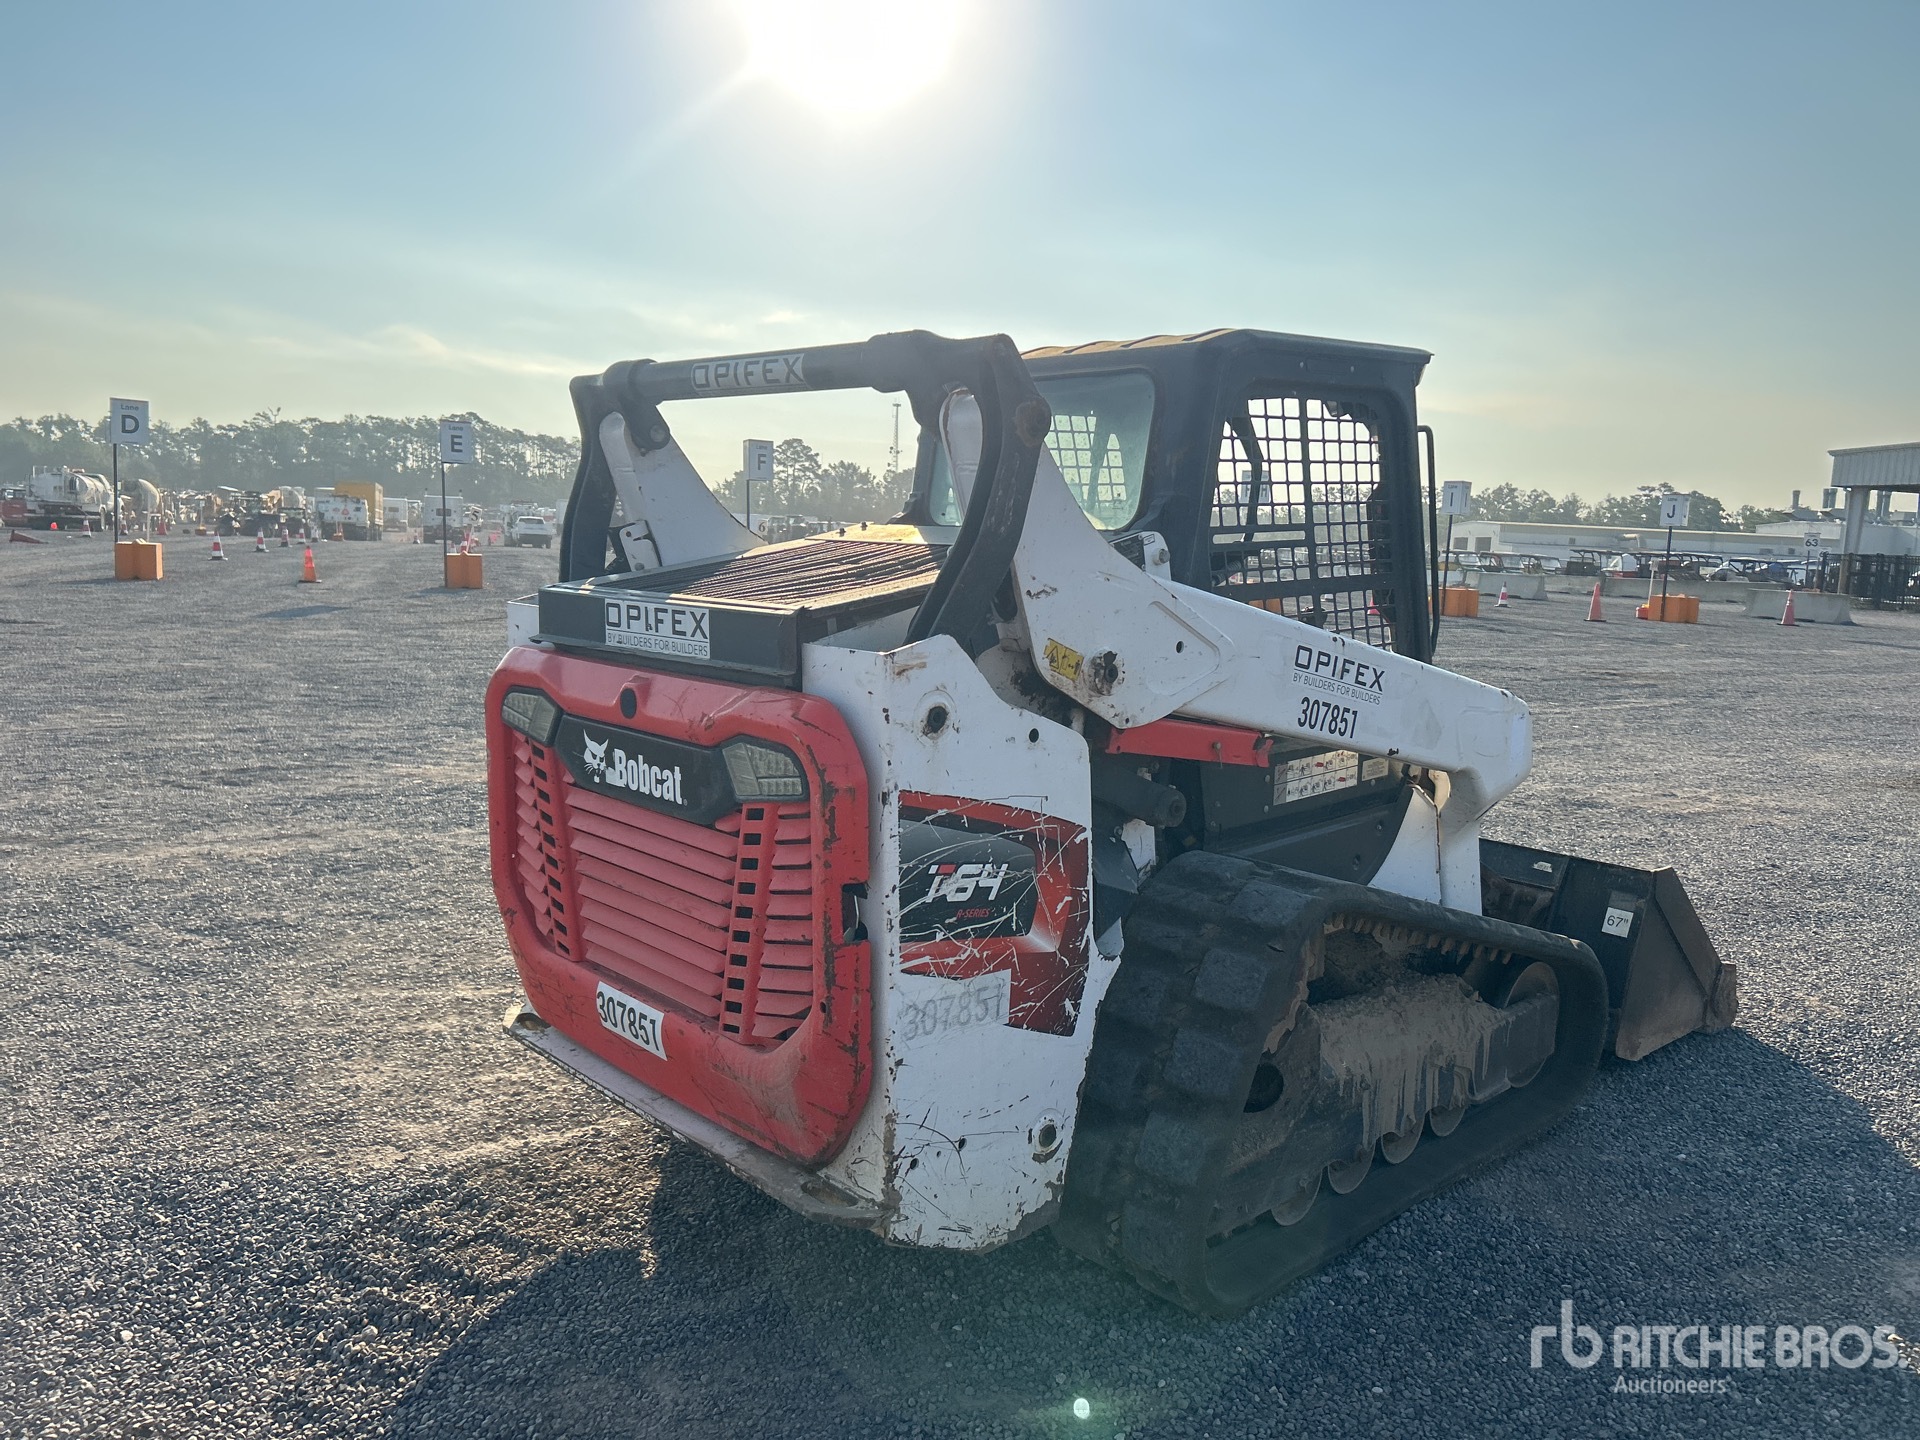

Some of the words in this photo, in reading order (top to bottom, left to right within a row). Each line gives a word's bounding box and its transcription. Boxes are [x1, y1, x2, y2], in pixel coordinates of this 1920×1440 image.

[693, 356, 804, 389] OPIFEX
[121, 414, 140, 434] D
[450, 434, 463, 453] E
[757, 453, 767, 471] F
[471, 510, 480, 522] 5
[1666, 504, 1676, 519] J
[758, 521, 766, 533] 6
[1805, 538, 1819, 547] 63
[605, 602, 708, 640] OPIFEX
[607, 632, 617, 643] BY
[618, 634, 653, 649] BUILDERS
[654, 638, 670, 652] FOR
[672, 640, 708, 657] BUILDERS
[1294, 645, 1386, 692] OPIFEX
[1292, 672, 1303, 684] BY
[1304, 675, 1336, 692] BUILDERS
[1337, 684, 1350, 696] FOR
[1351, 689, 1381, 706] BUILDERS
[1297, 697, 1358, 739] 307851
[605, 748, 682, 805] Bobcat
[925, 862, 1009, 903] T64
[1606, 915, 1629, 928] 67"
[596, 991, 660, 1052] 307851
[903, 984, 1005, 1042] 307851
